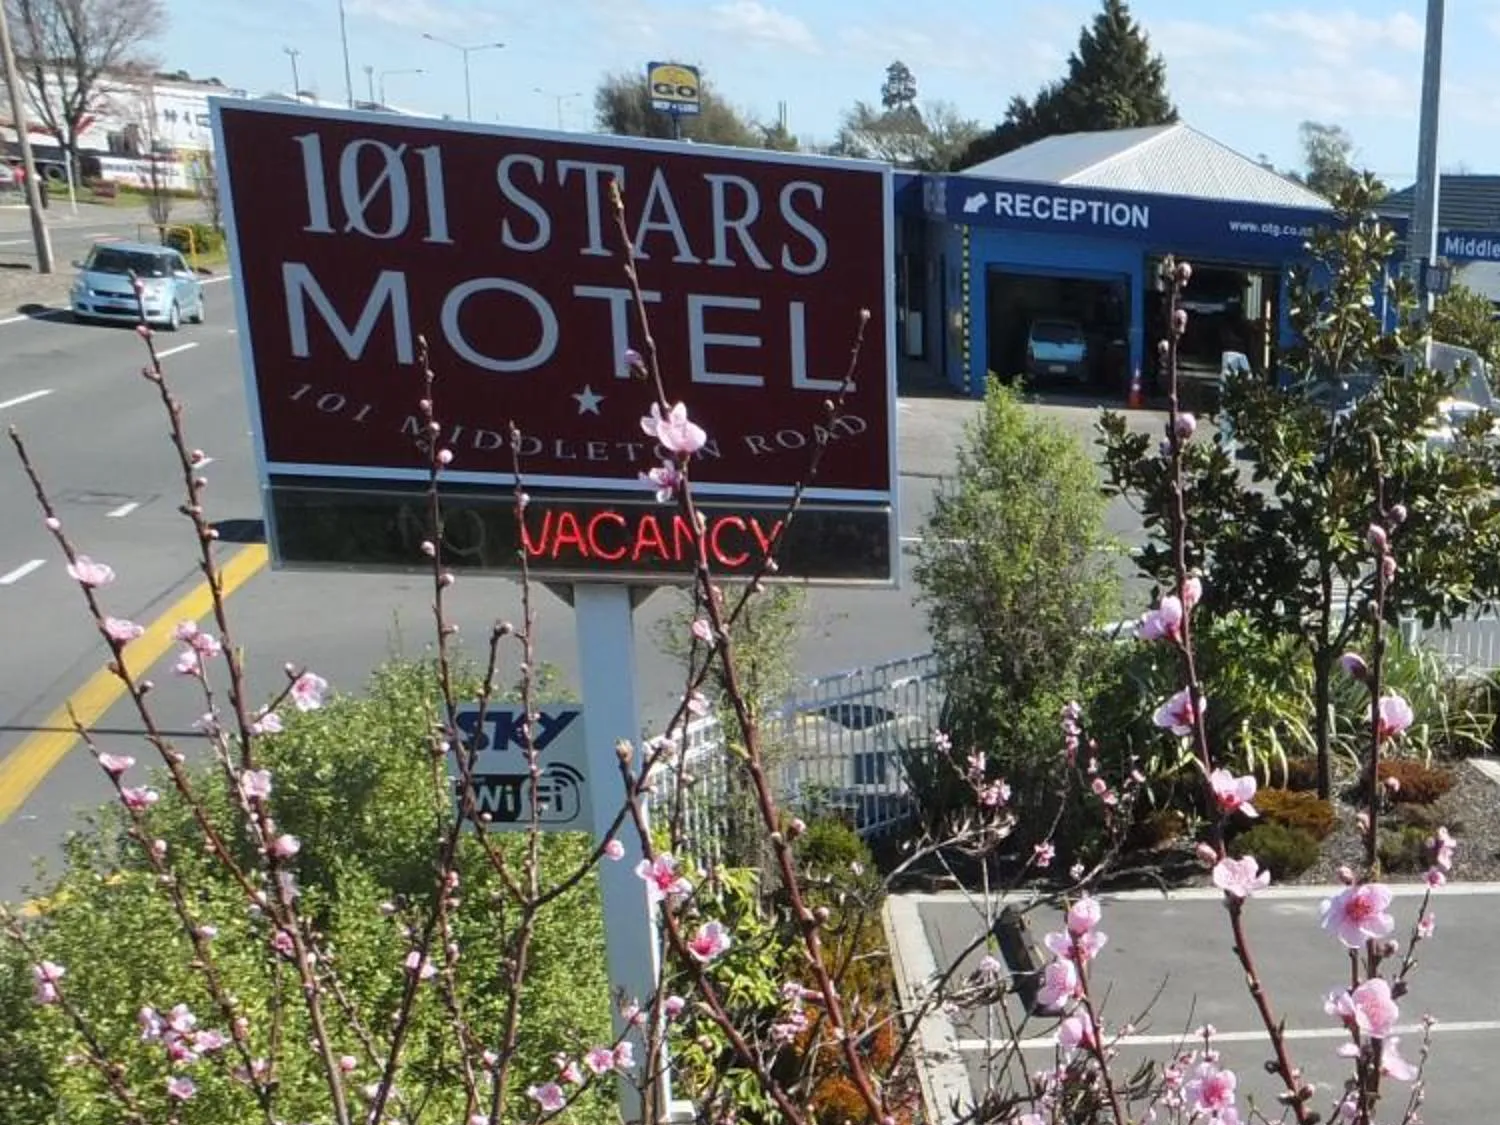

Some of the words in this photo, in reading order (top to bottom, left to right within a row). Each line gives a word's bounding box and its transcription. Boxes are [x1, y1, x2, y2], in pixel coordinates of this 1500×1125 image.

[291, 131, 453, 244] 101
[496, 152, 828, 275] STARS
[994, 191, 1150, 228] RECEPTION
[282, 261, 857, 392] MOTEL
[289, 383, 372, 422] 101
[744, 414, 867, 455] ROAD
[520, 510, 784, 567] VACANCY
[450, 711, 581, 750] SKY
